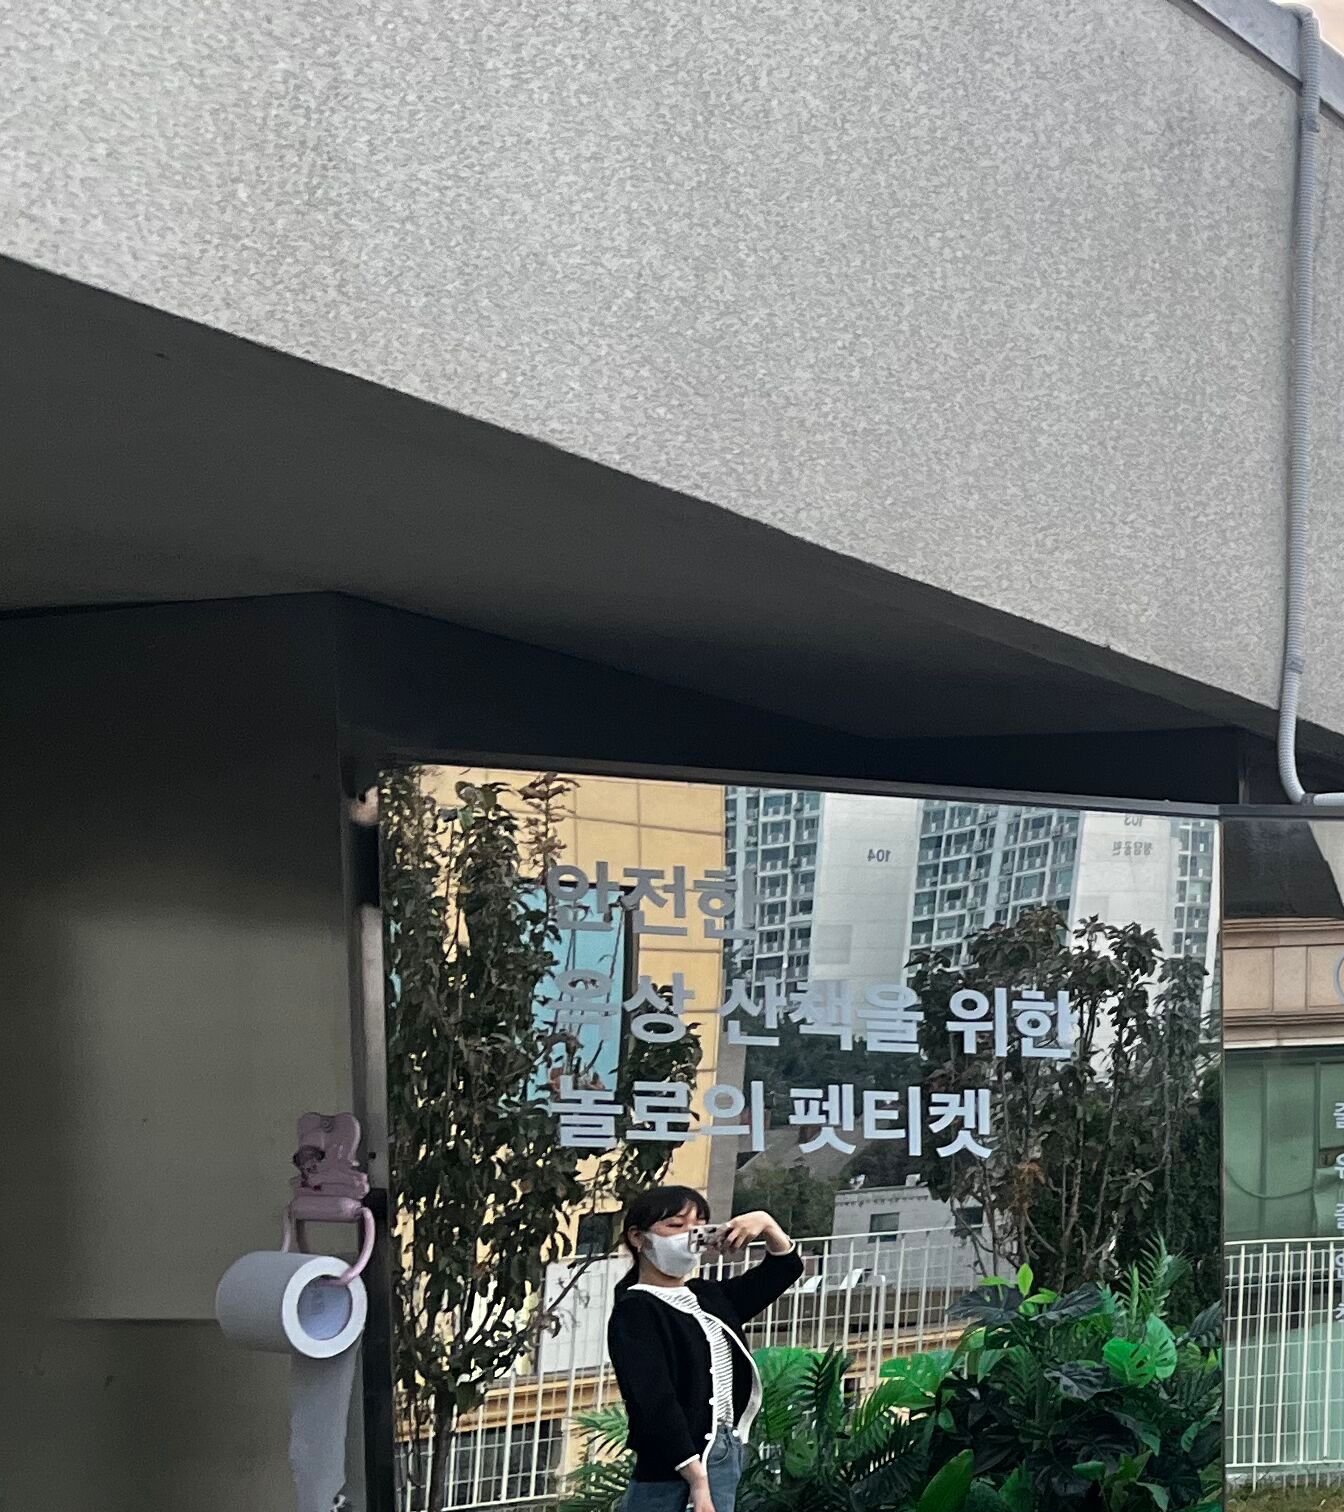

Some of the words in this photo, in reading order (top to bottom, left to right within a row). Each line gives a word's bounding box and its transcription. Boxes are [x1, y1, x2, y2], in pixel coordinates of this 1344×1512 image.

[545, 861, 756, 940] 안전한
[549, 969, 695, 1044] 옥상
[719, 975, 925, 1053] 산책을
[946, 988, 1079, 1058] 위한
[551, 1075, 765, 1152] 놀로의
[788, 1083, 993, 1159] 펫티켓
